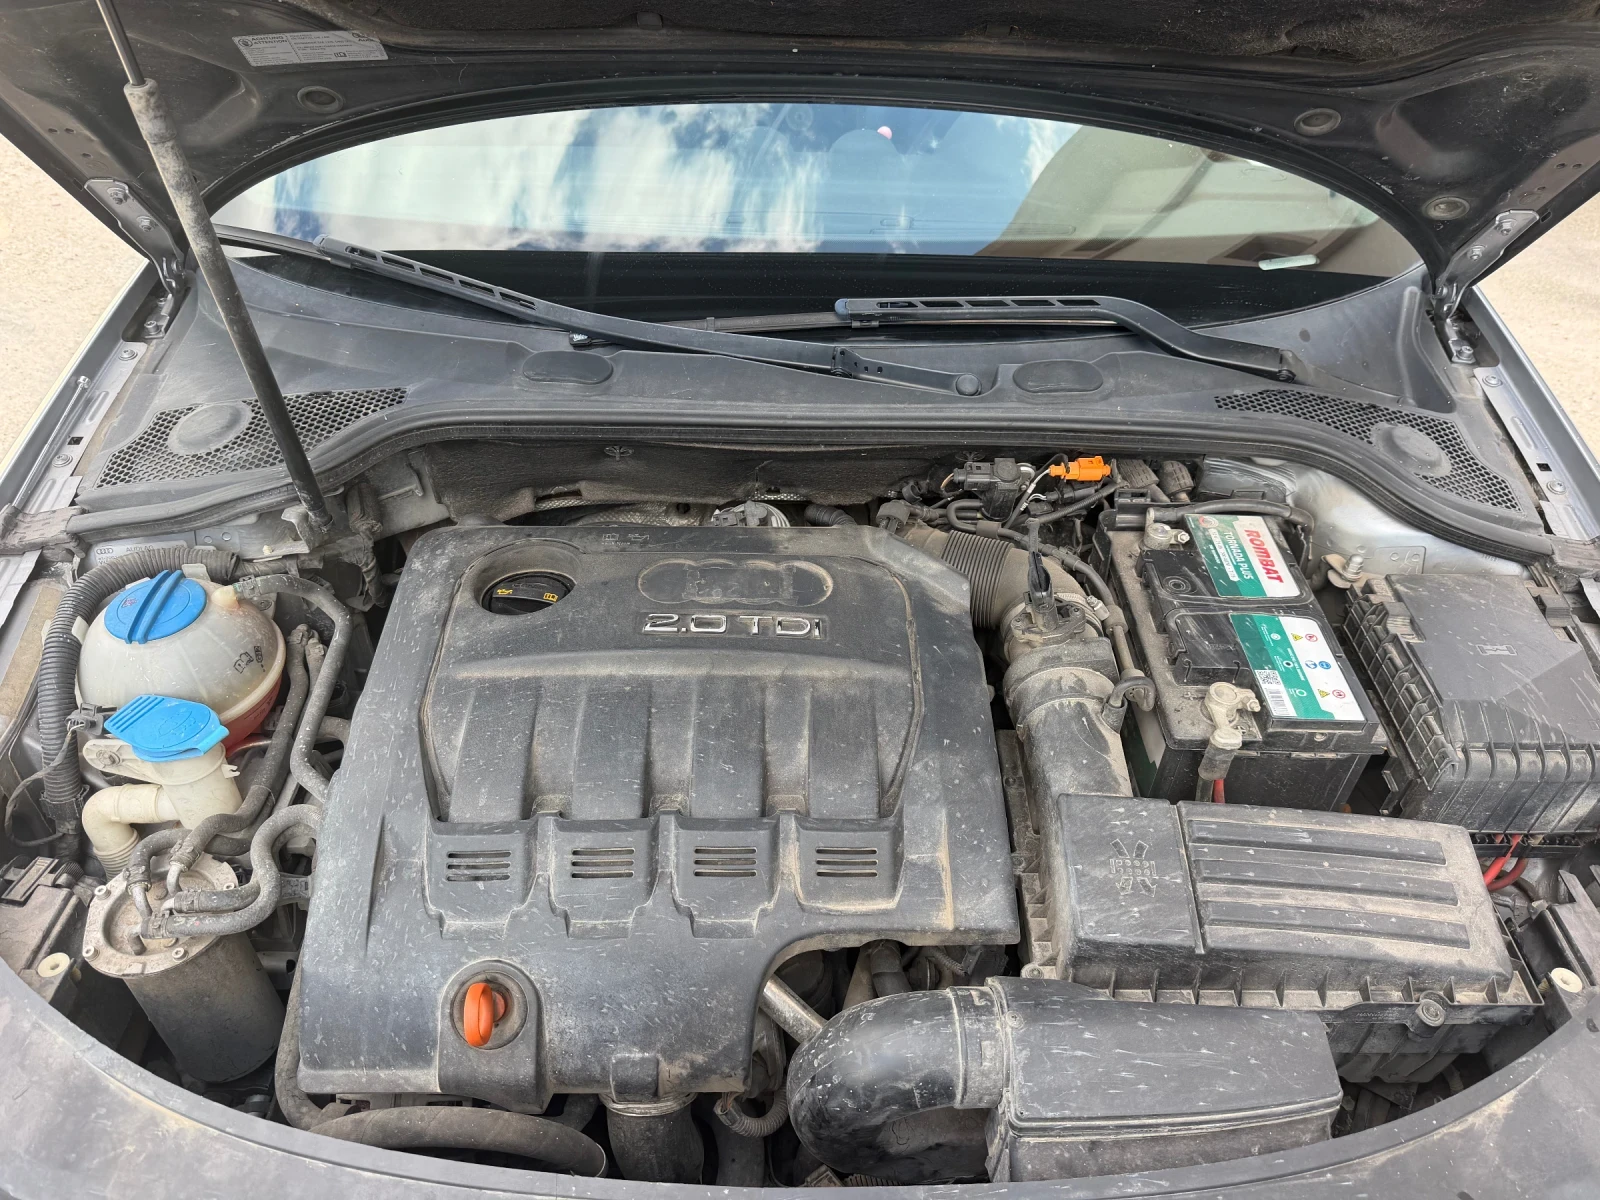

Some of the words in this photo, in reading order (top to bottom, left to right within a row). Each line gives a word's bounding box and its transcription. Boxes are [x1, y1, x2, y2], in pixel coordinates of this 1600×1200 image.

[1223, 532, 1246, 562] TORNADA
[1238, 562, 1254, 580] PLUS
[1244, 529, 1284, 583] ROMBAT
[642, 613, 726, 634] 2.0
[739, 615, 822, 640] TDI
